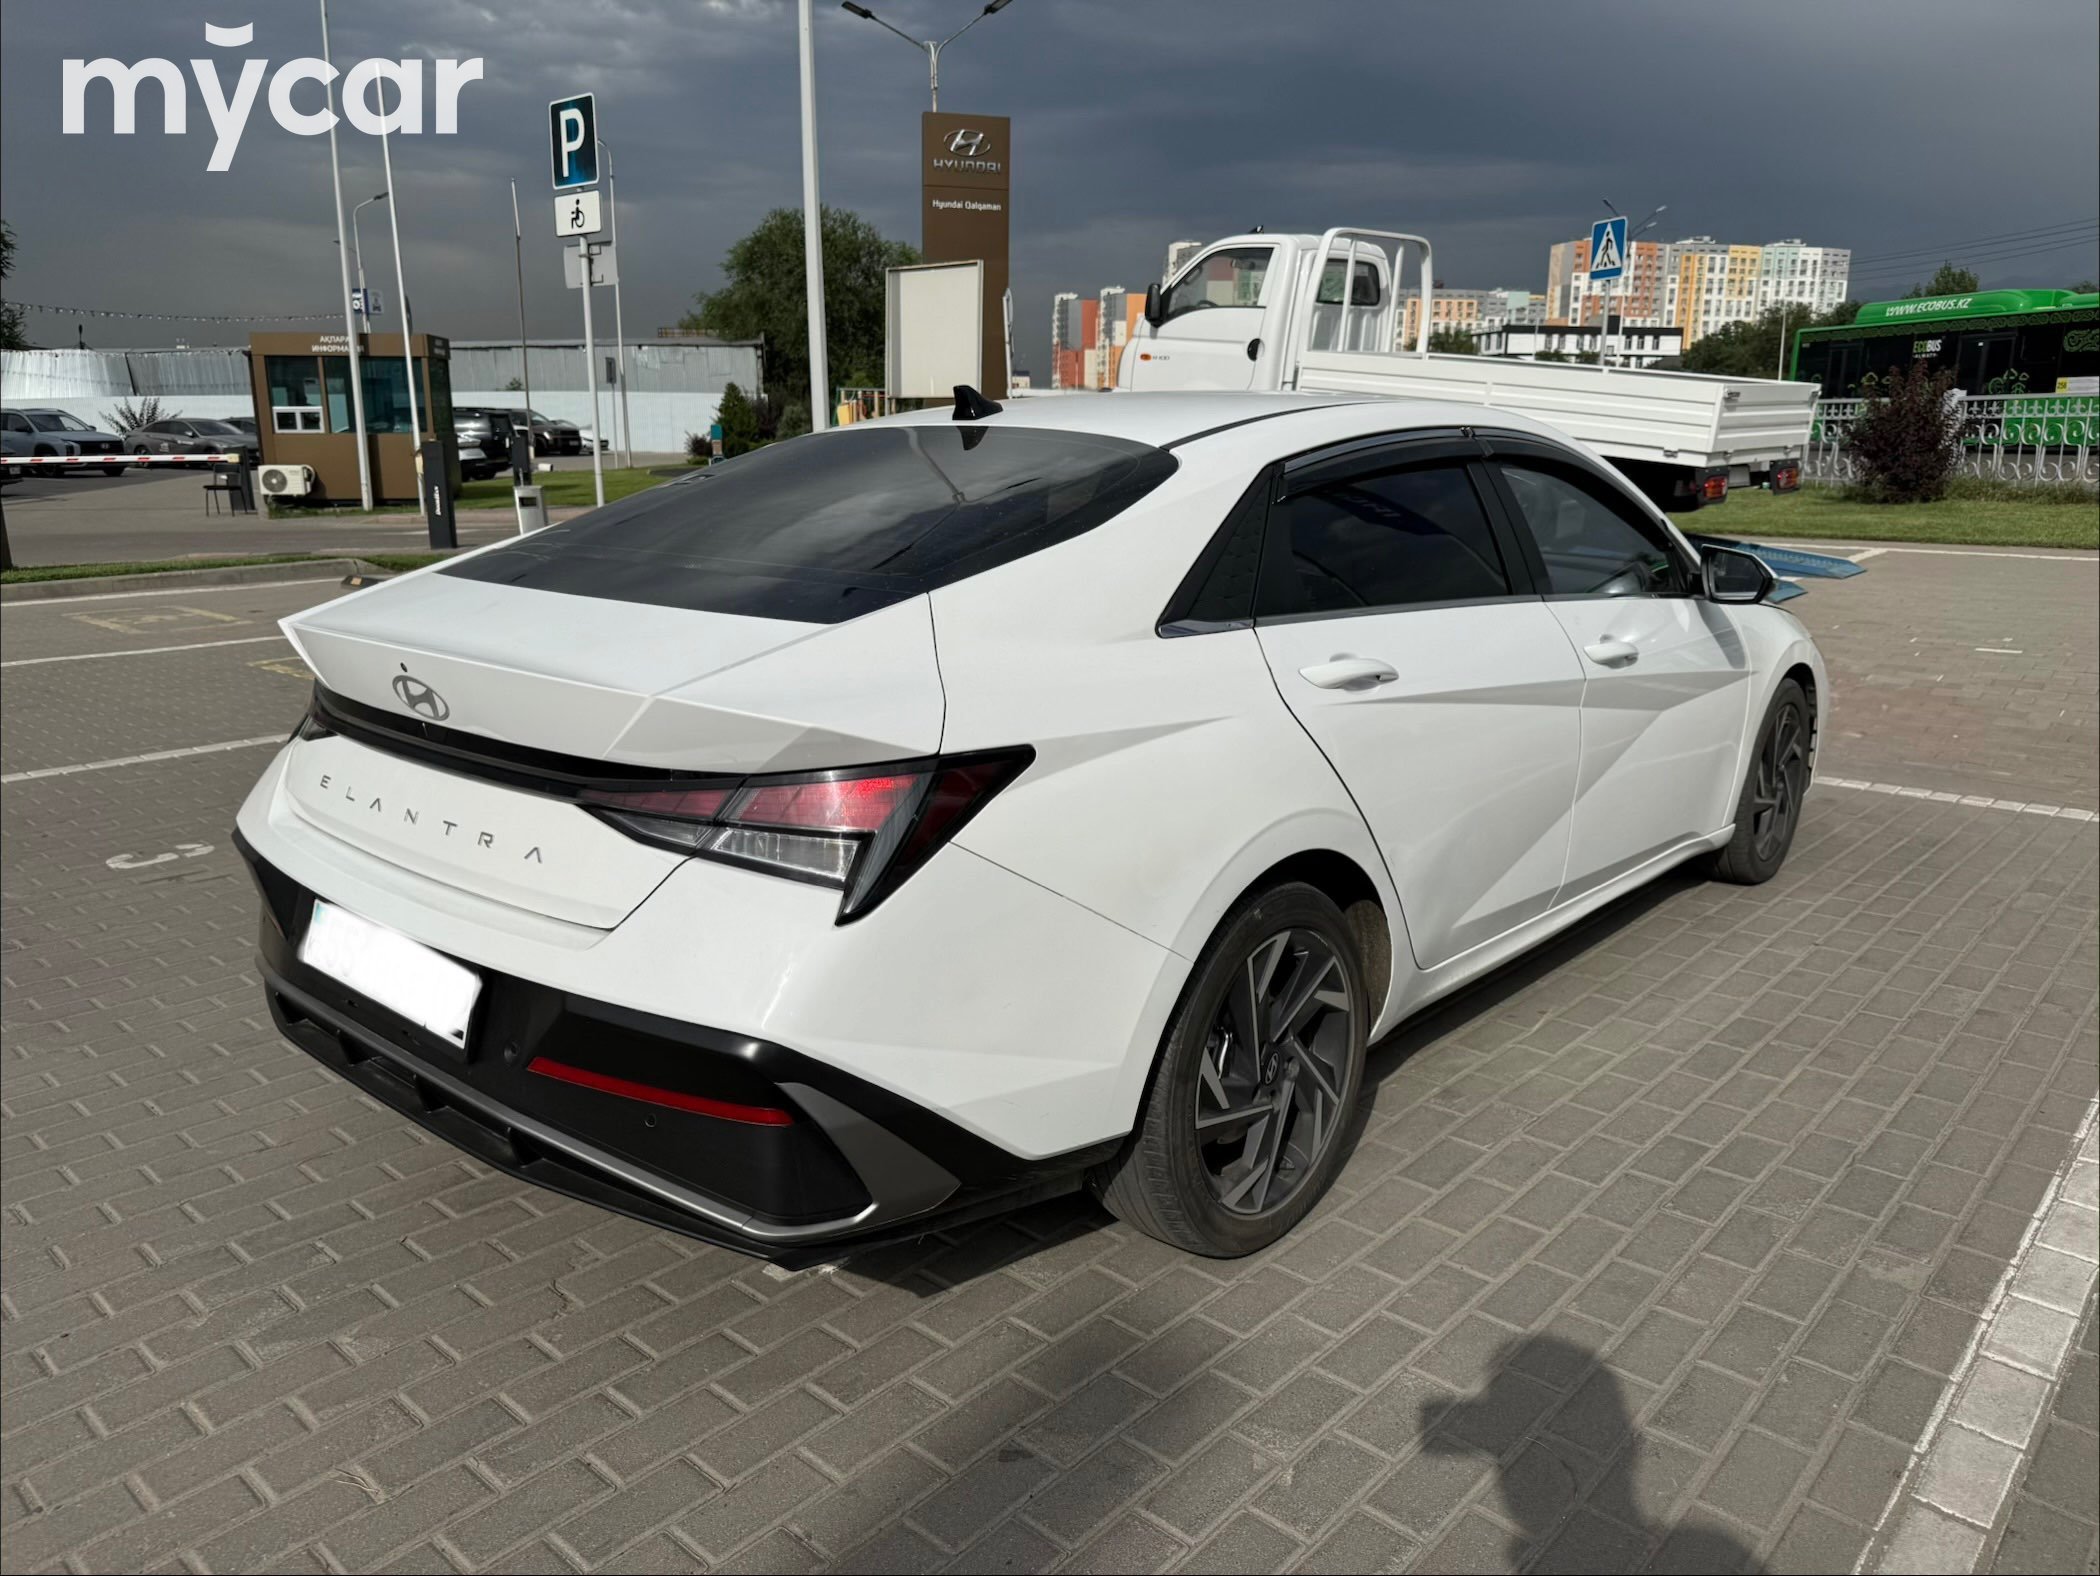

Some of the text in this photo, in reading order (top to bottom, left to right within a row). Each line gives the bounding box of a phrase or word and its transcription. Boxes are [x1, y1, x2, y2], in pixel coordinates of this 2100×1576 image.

[559, 107, 586, 178] P
[933, 158, 1001, 172] HYUNDAI
[932, 199, 963, 210] Hyundai
[1885, 298, 1972, 316] WWW.ECOBUS.KZ
[319, 774, 544, 865] ELANTRA
